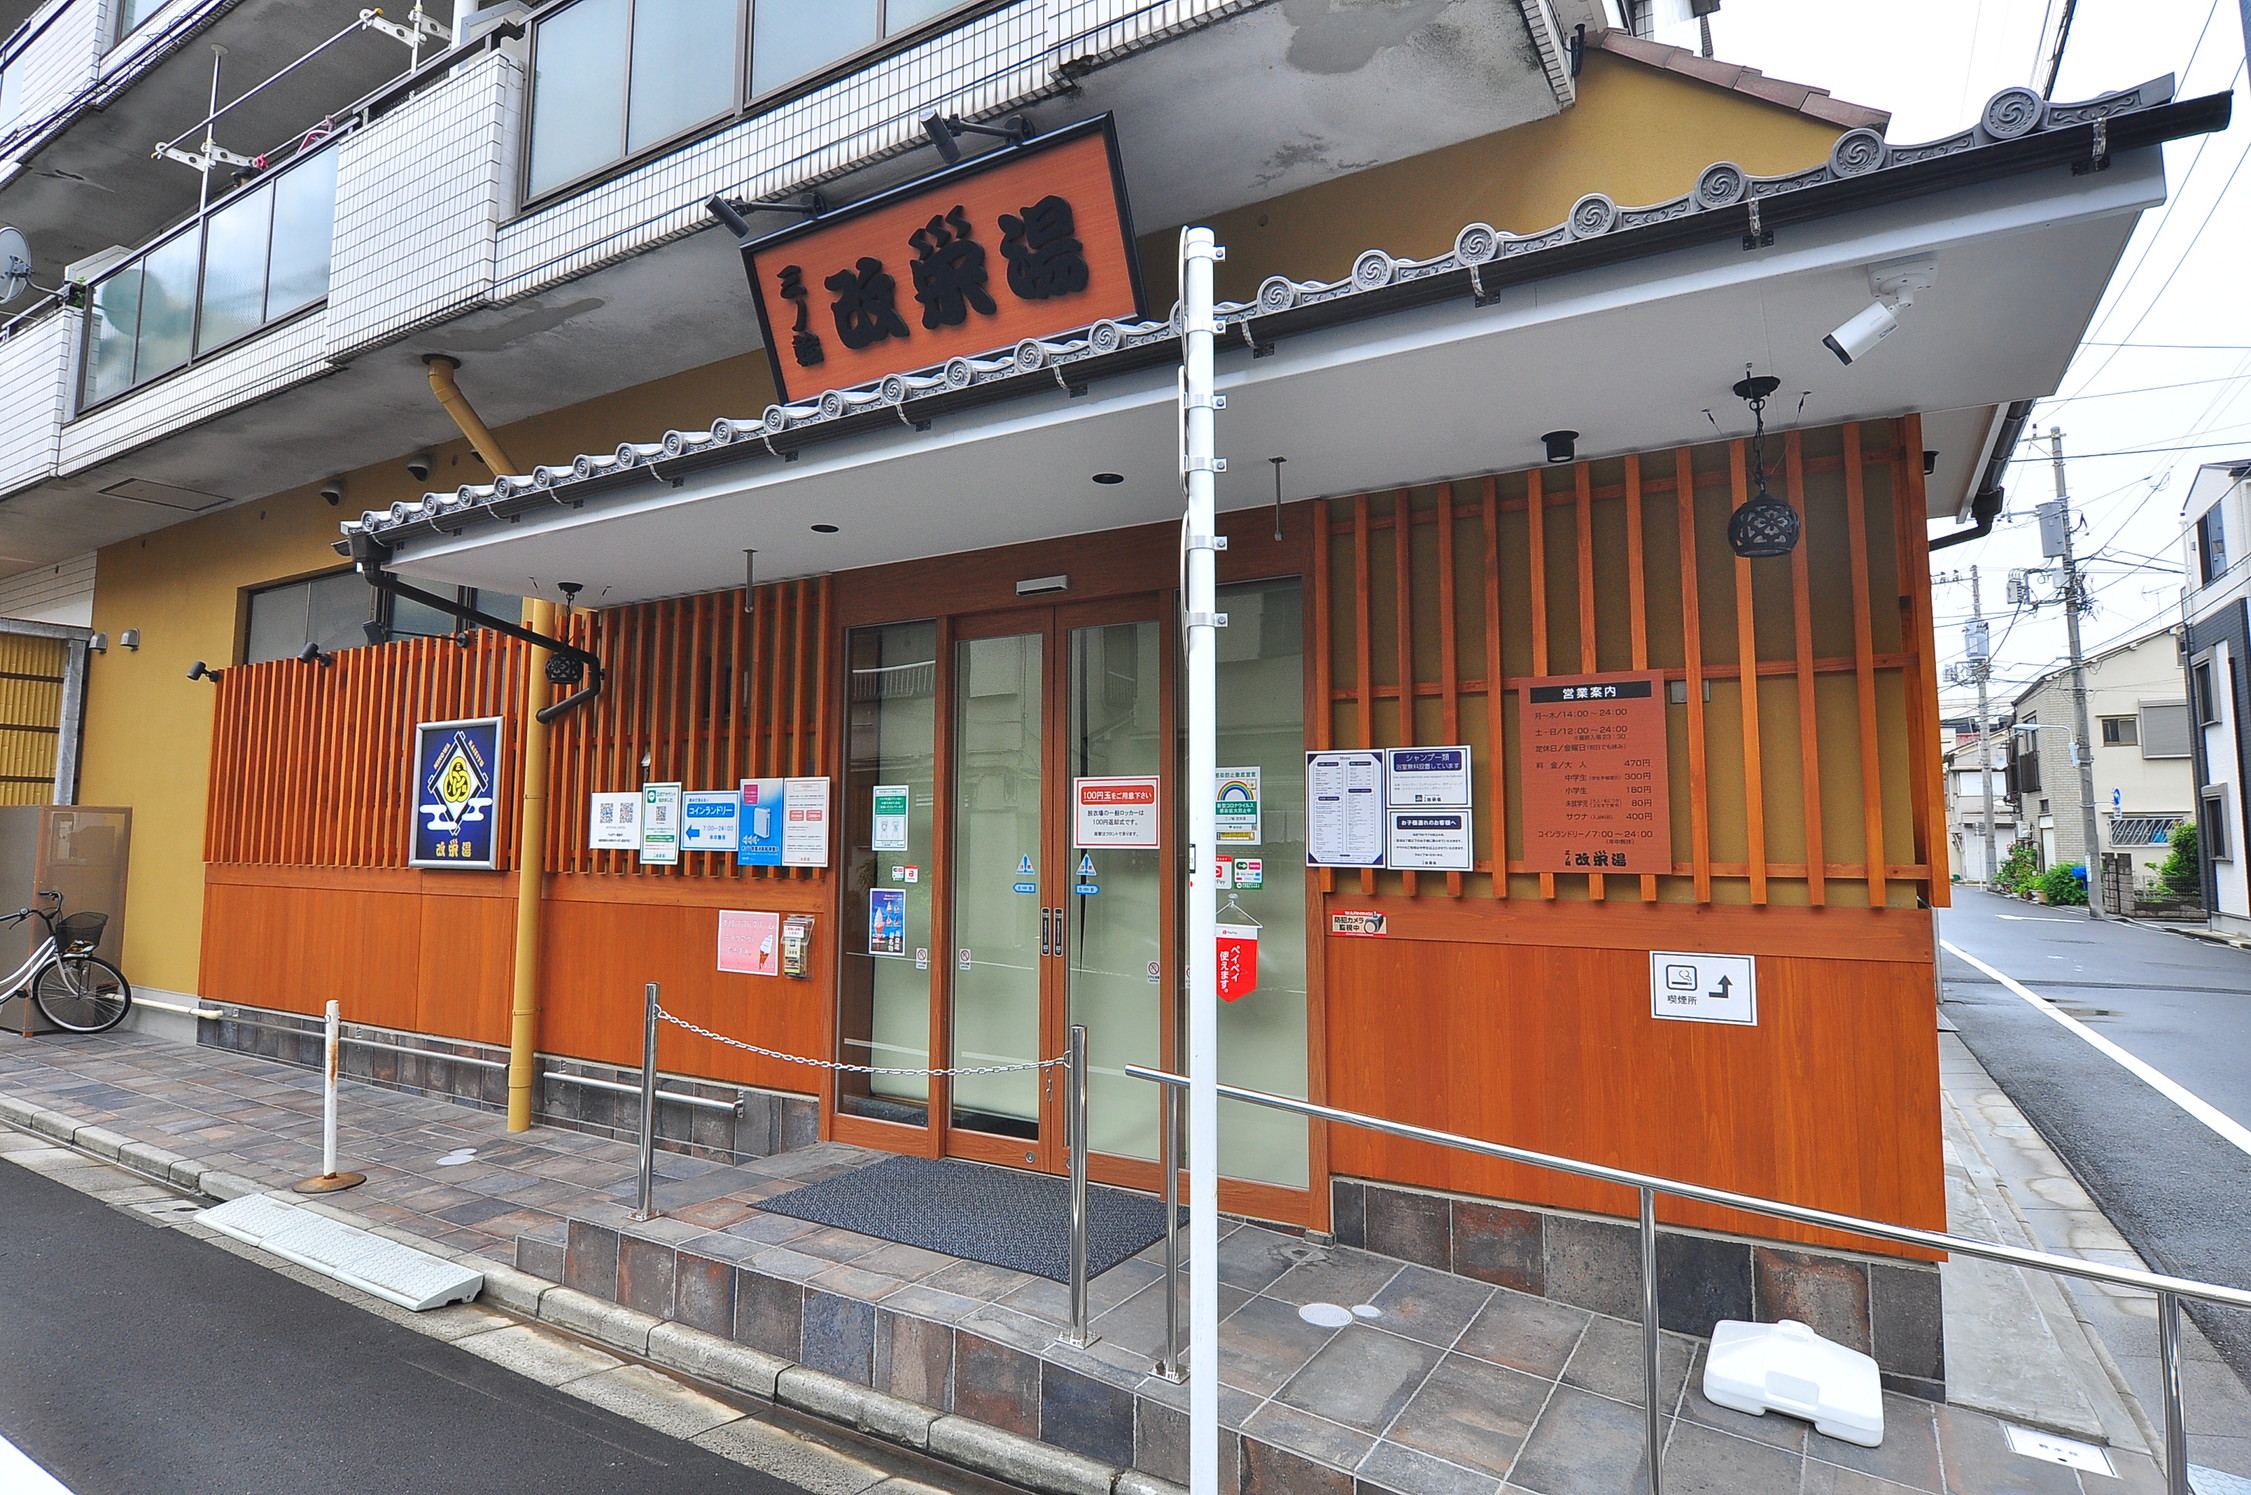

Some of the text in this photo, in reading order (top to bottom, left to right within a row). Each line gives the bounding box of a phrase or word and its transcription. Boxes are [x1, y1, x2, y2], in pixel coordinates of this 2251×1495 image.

[1562, 685, 1616, 700] 営業案内
[1405, 753, 1450, 762] シャンプー類
[1624, 759, 1651, 767] 470円
[1564, 774, 1587, 782] 中学生
[1624, 772, 1651, 780] 300円
[1564, 785, 1652, 795] 小学生 180円
[1083, 791, 1153, 800] 100円玉をご用意下さい
[1631, 799, 1652, 807] 80円
[688, 805, 733, 815] コインランドリー
[1626, 812, 1653, 821] 400円
[1334, 916, 1364, 924] 防犯カメラ
[1230, 945, 1240, 982] ペイペイ
[1219, 951, 1230, 993] 使えます。
[1667, 994, 1697, 1006] 喫煙所
